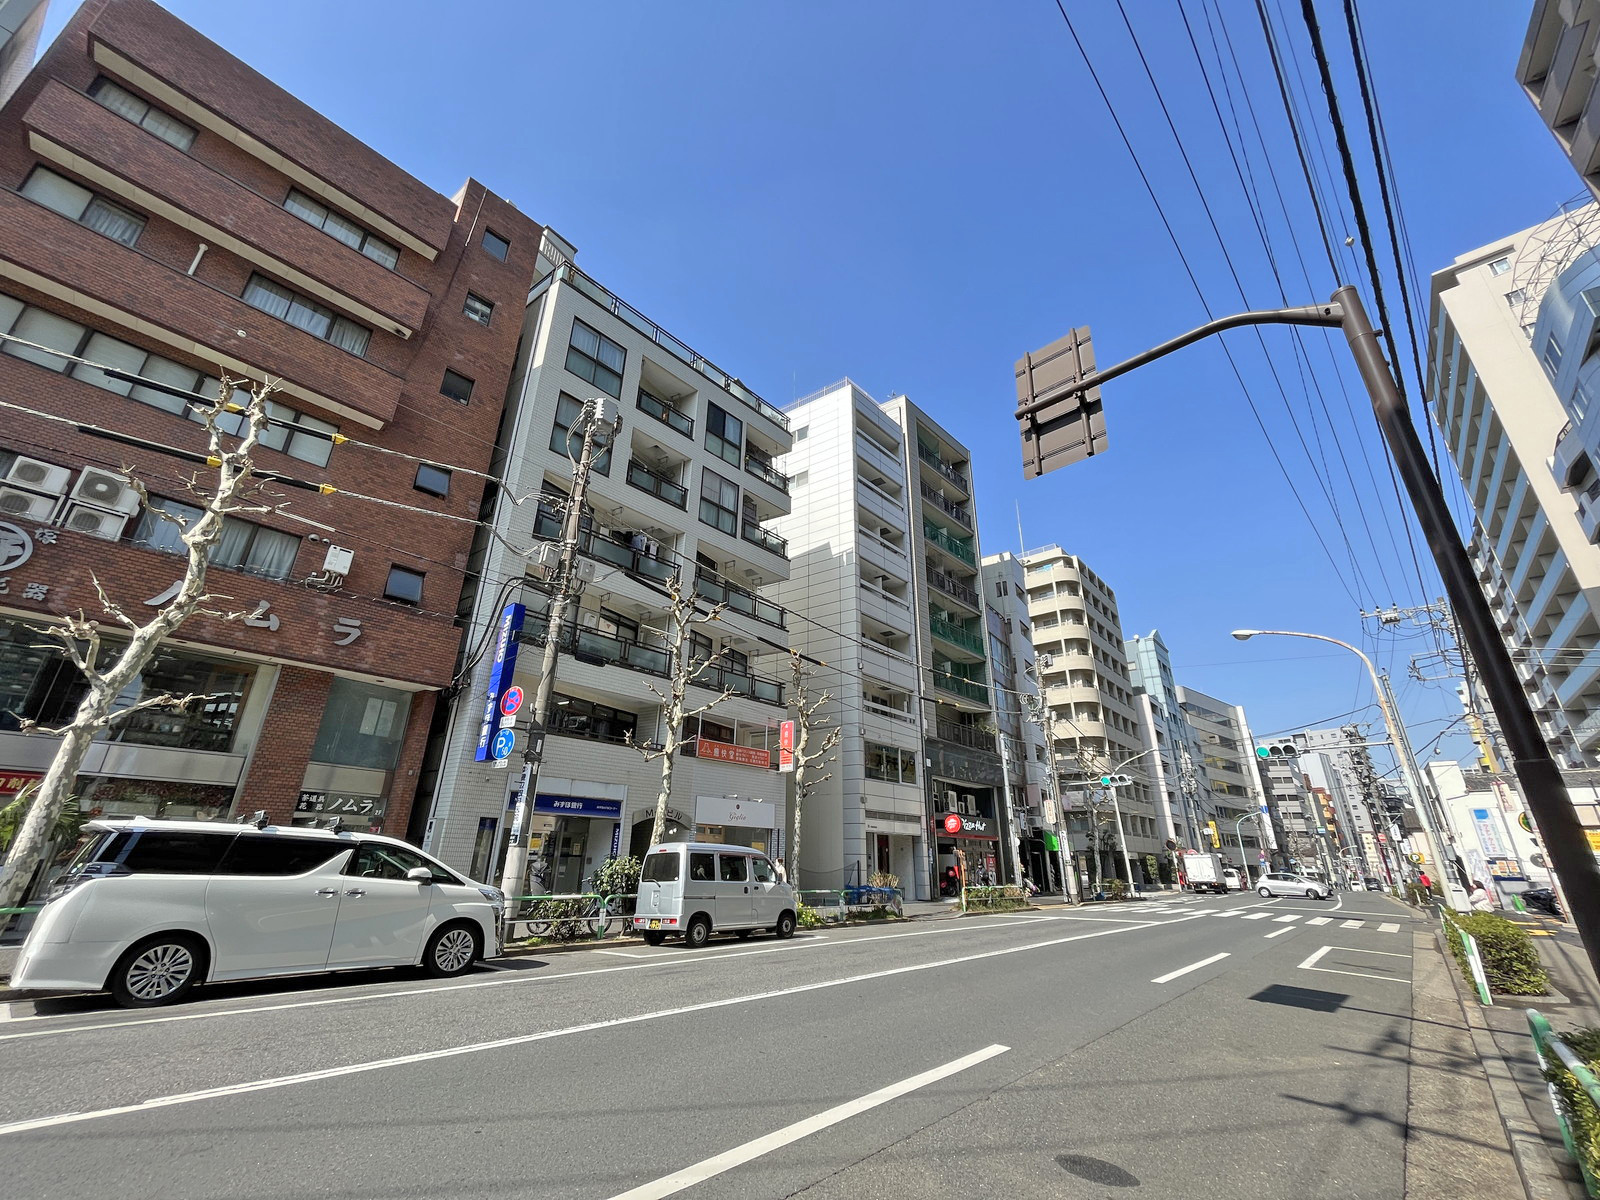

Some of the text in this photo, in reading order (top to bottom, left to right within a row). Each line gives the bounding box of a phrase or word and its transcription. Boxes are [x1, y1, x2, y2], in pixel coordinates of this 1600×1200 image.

[497, 614, 512, 663] MIZUHO
[479, 692, 496, 749] みずほ銀行
[496, 737, 506, 757] P
[302, 794, 325, 803] 茶道具
[327, 797, 374, 814] ノムラ
[553, 800, 583, 810] みずほ銀行
[612, 828, 620, 857] MIZUHO
